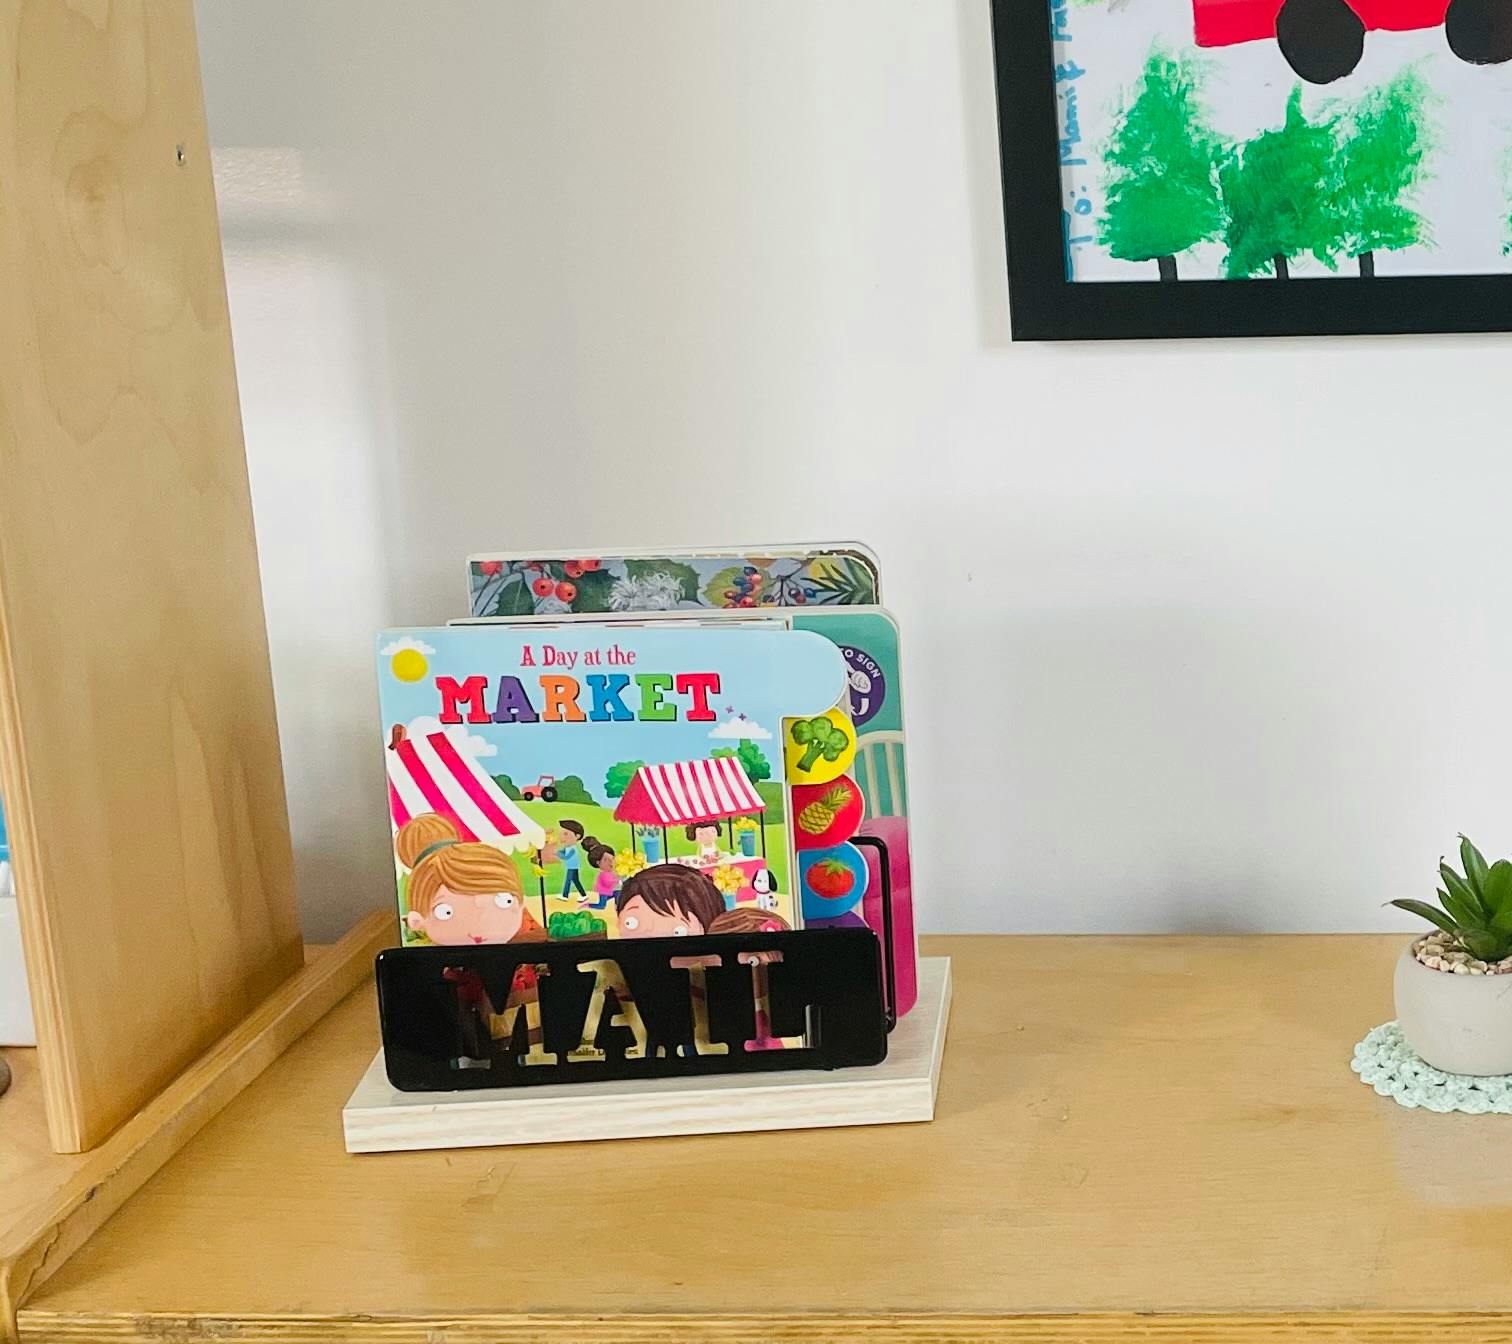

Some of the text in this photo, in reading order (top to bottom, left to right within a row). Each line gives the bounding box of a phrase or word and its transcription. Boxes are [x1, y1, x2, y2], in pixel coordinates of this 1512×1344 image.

[1063, 185, 1093, 282] To:
[520, 644, 637, 670] A Day at the
[855, 653, 882, 680] SIGN
[435, 672, 721, 725] MARKET
[442, 950, 822, 1071] MAIL
